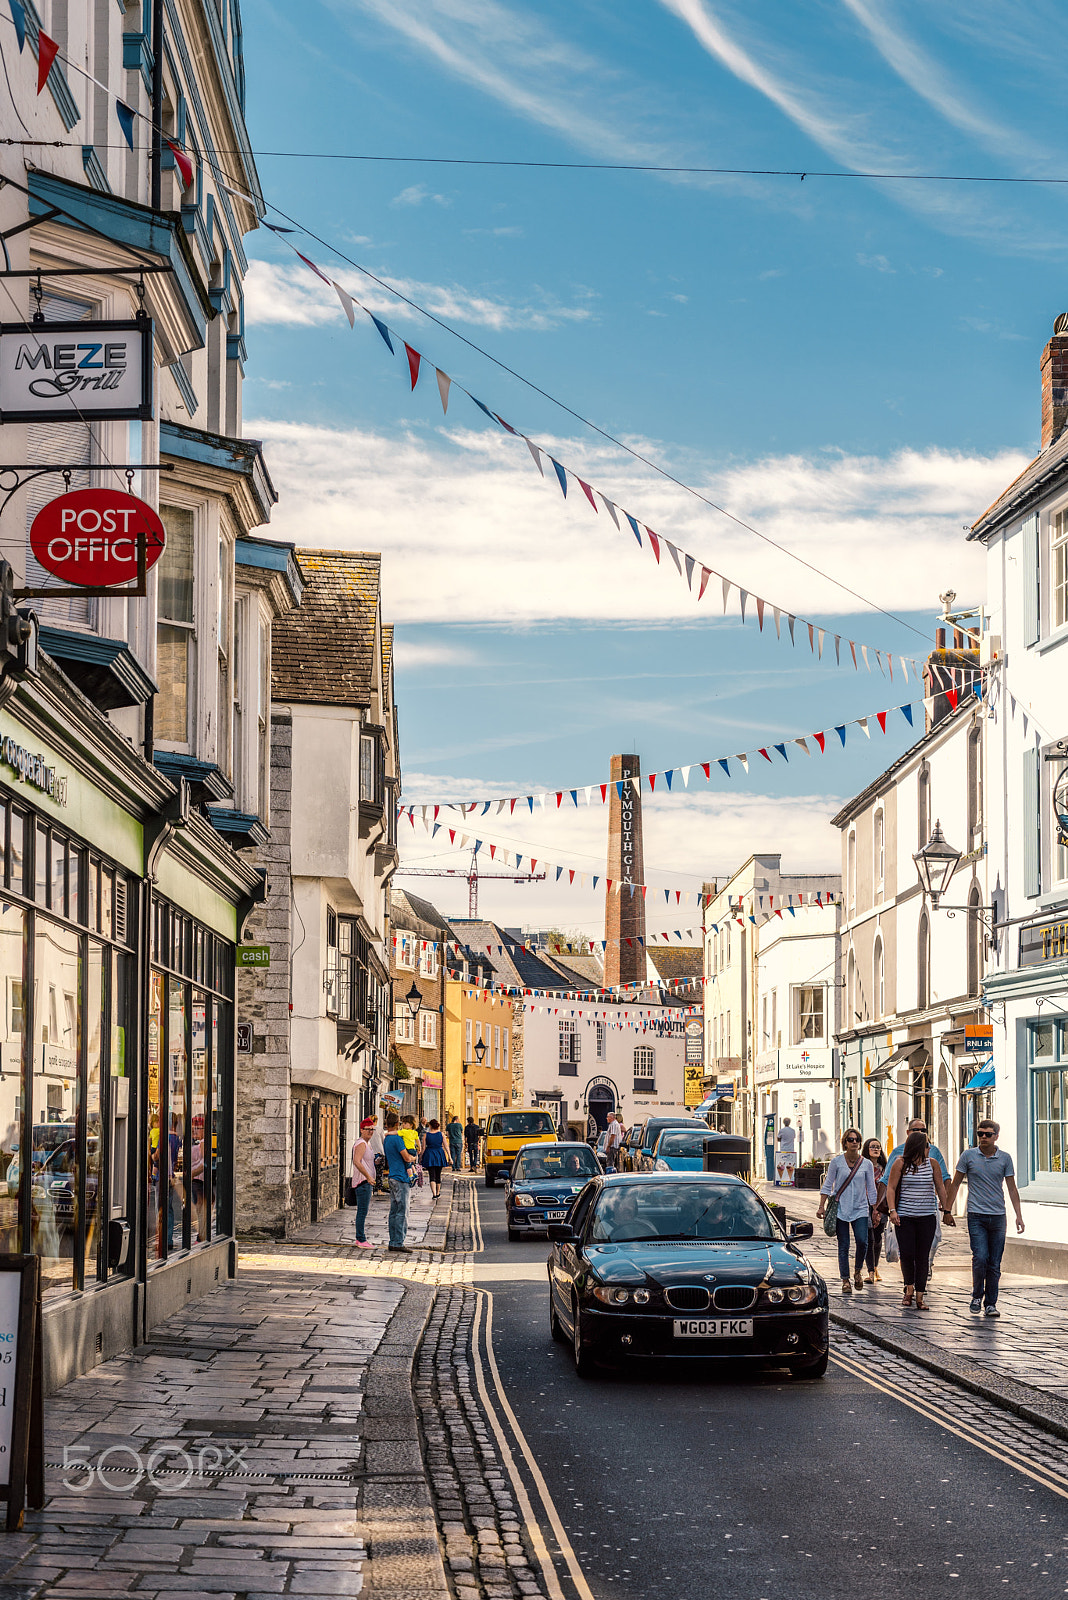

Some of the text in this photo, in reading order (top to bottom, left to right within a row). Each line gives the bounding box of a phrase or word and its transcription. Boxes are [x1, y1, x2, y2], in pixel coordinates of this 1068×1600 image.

[15, 343, 127, 370] MEZE
[29, 369, 126, 398] Grill
[61, 509, 137, 533] POST
[622, 769, 633, 884] PLYMOUTH GIN
[242, 950, 269, 961] cash
[680, 1321, 748, 1335] WG03 FKC
